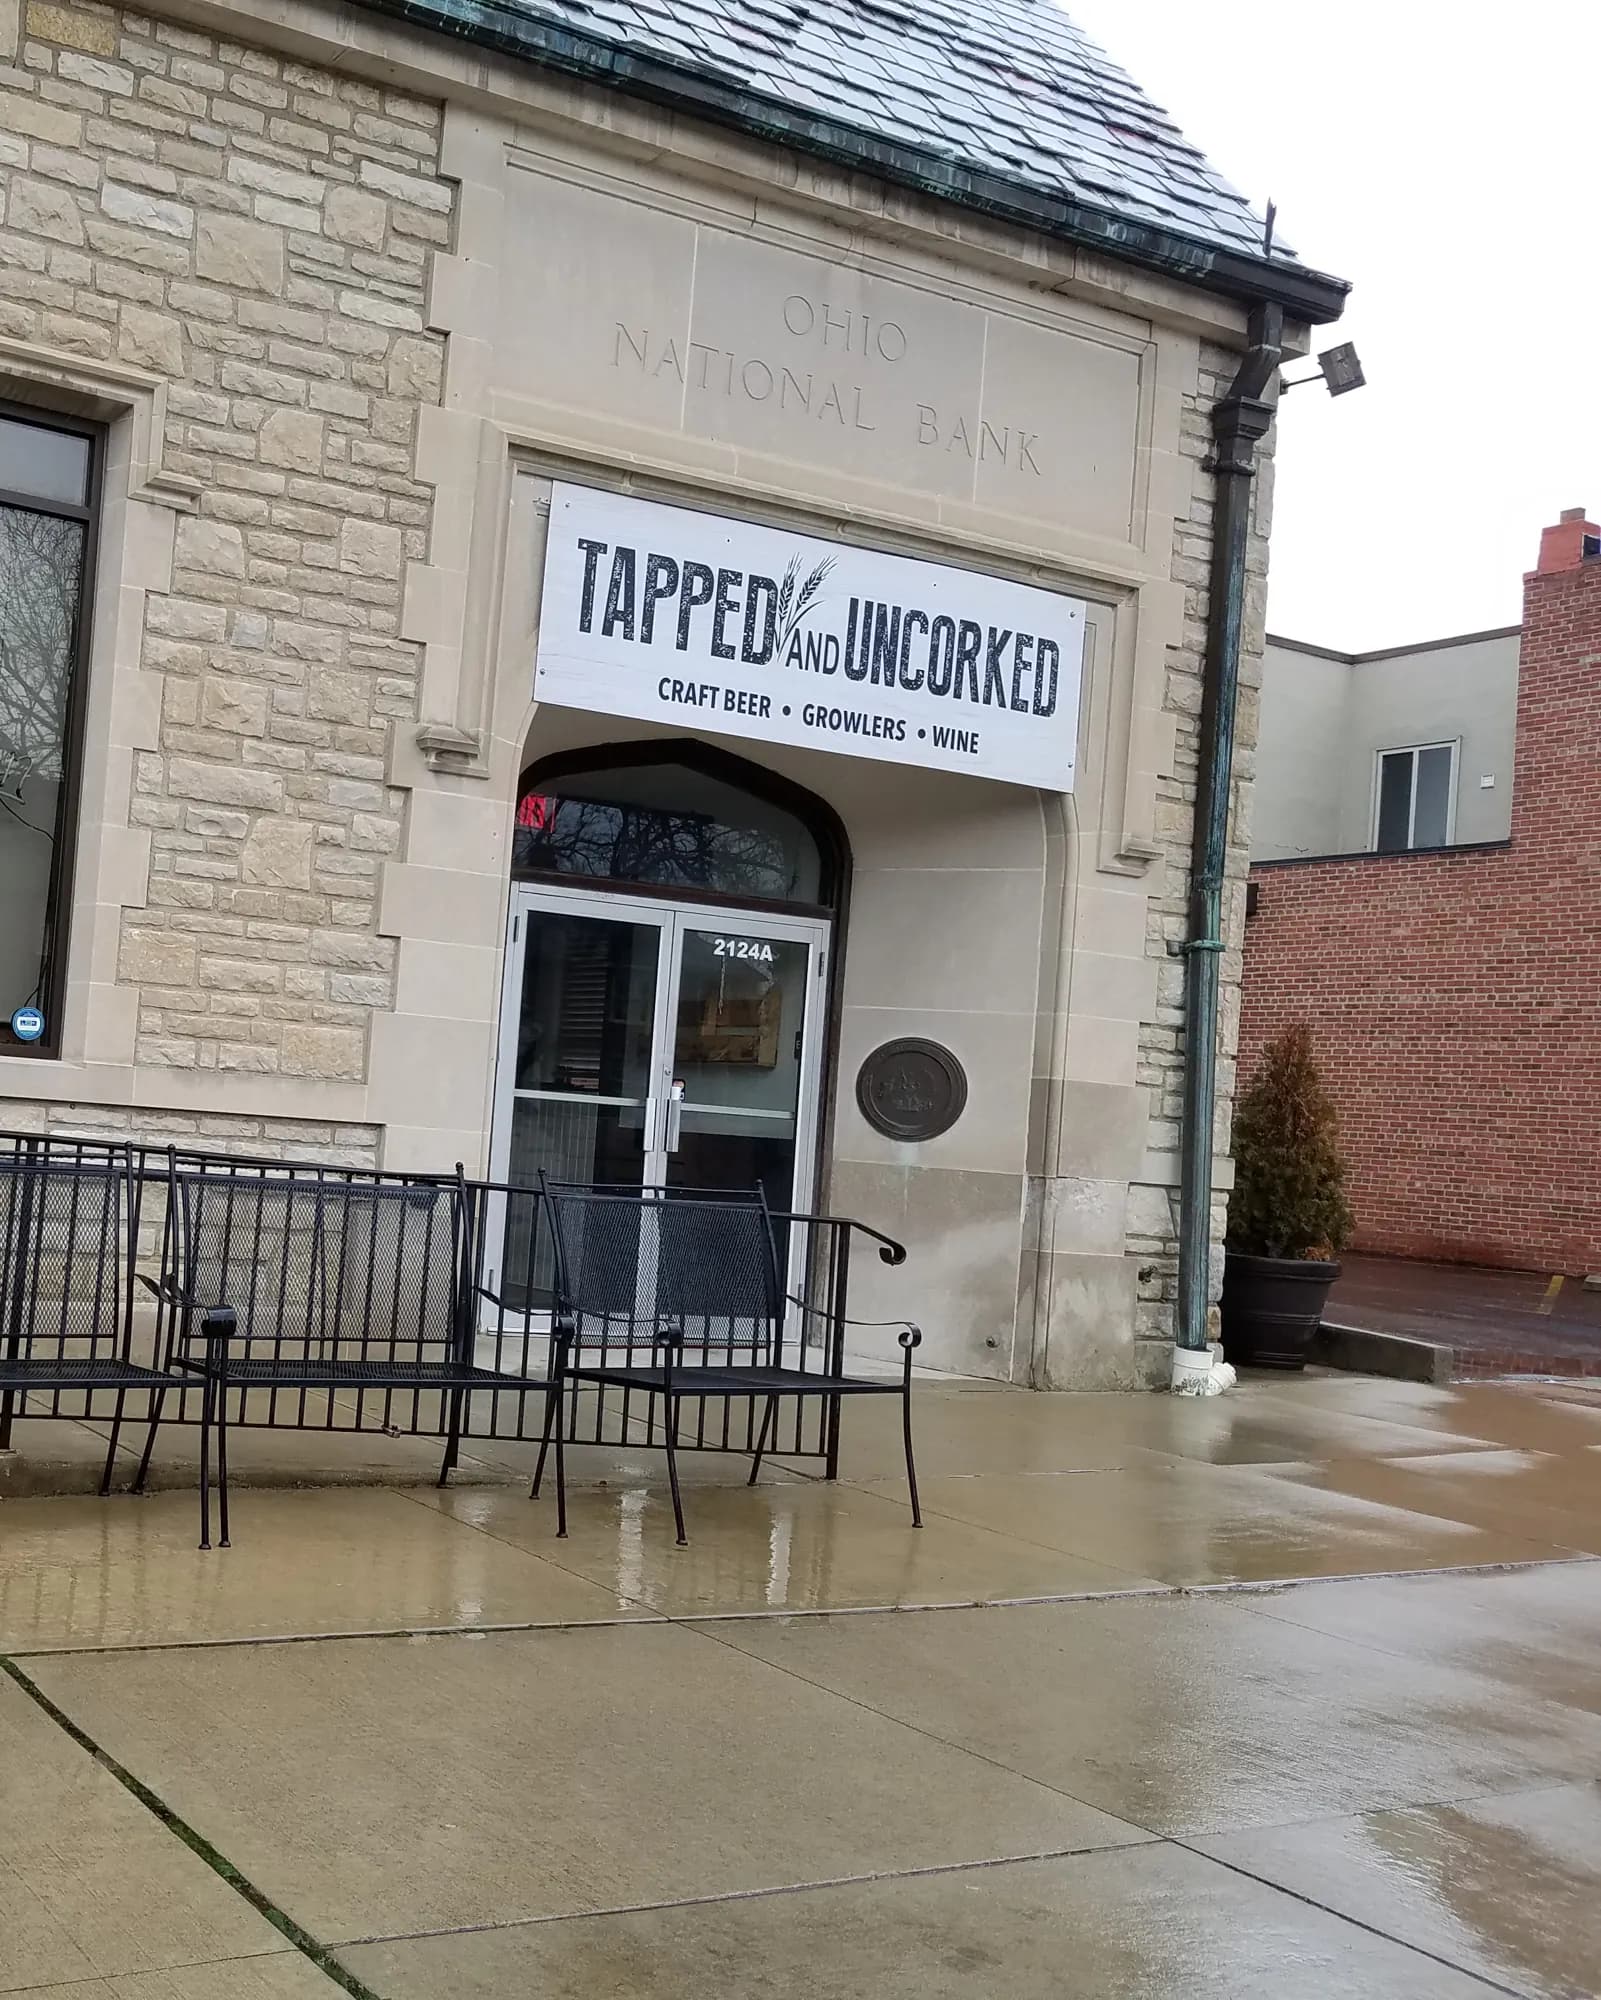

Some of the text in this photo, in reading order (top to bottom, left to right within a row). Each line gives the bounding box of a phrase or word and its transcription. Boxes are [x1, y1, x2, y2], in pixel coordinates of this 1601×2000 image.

[783, 295, 907, 362] OHIO
[610, 321, 1041, 476] NATIONAL BANK
[577, 537, 1061, 718] TAPPED AND UNCORKED
[658, 677, 980, 754] CRAFT BEER GROWLERS WINE
[713, 938, 773, 962] 2124A
